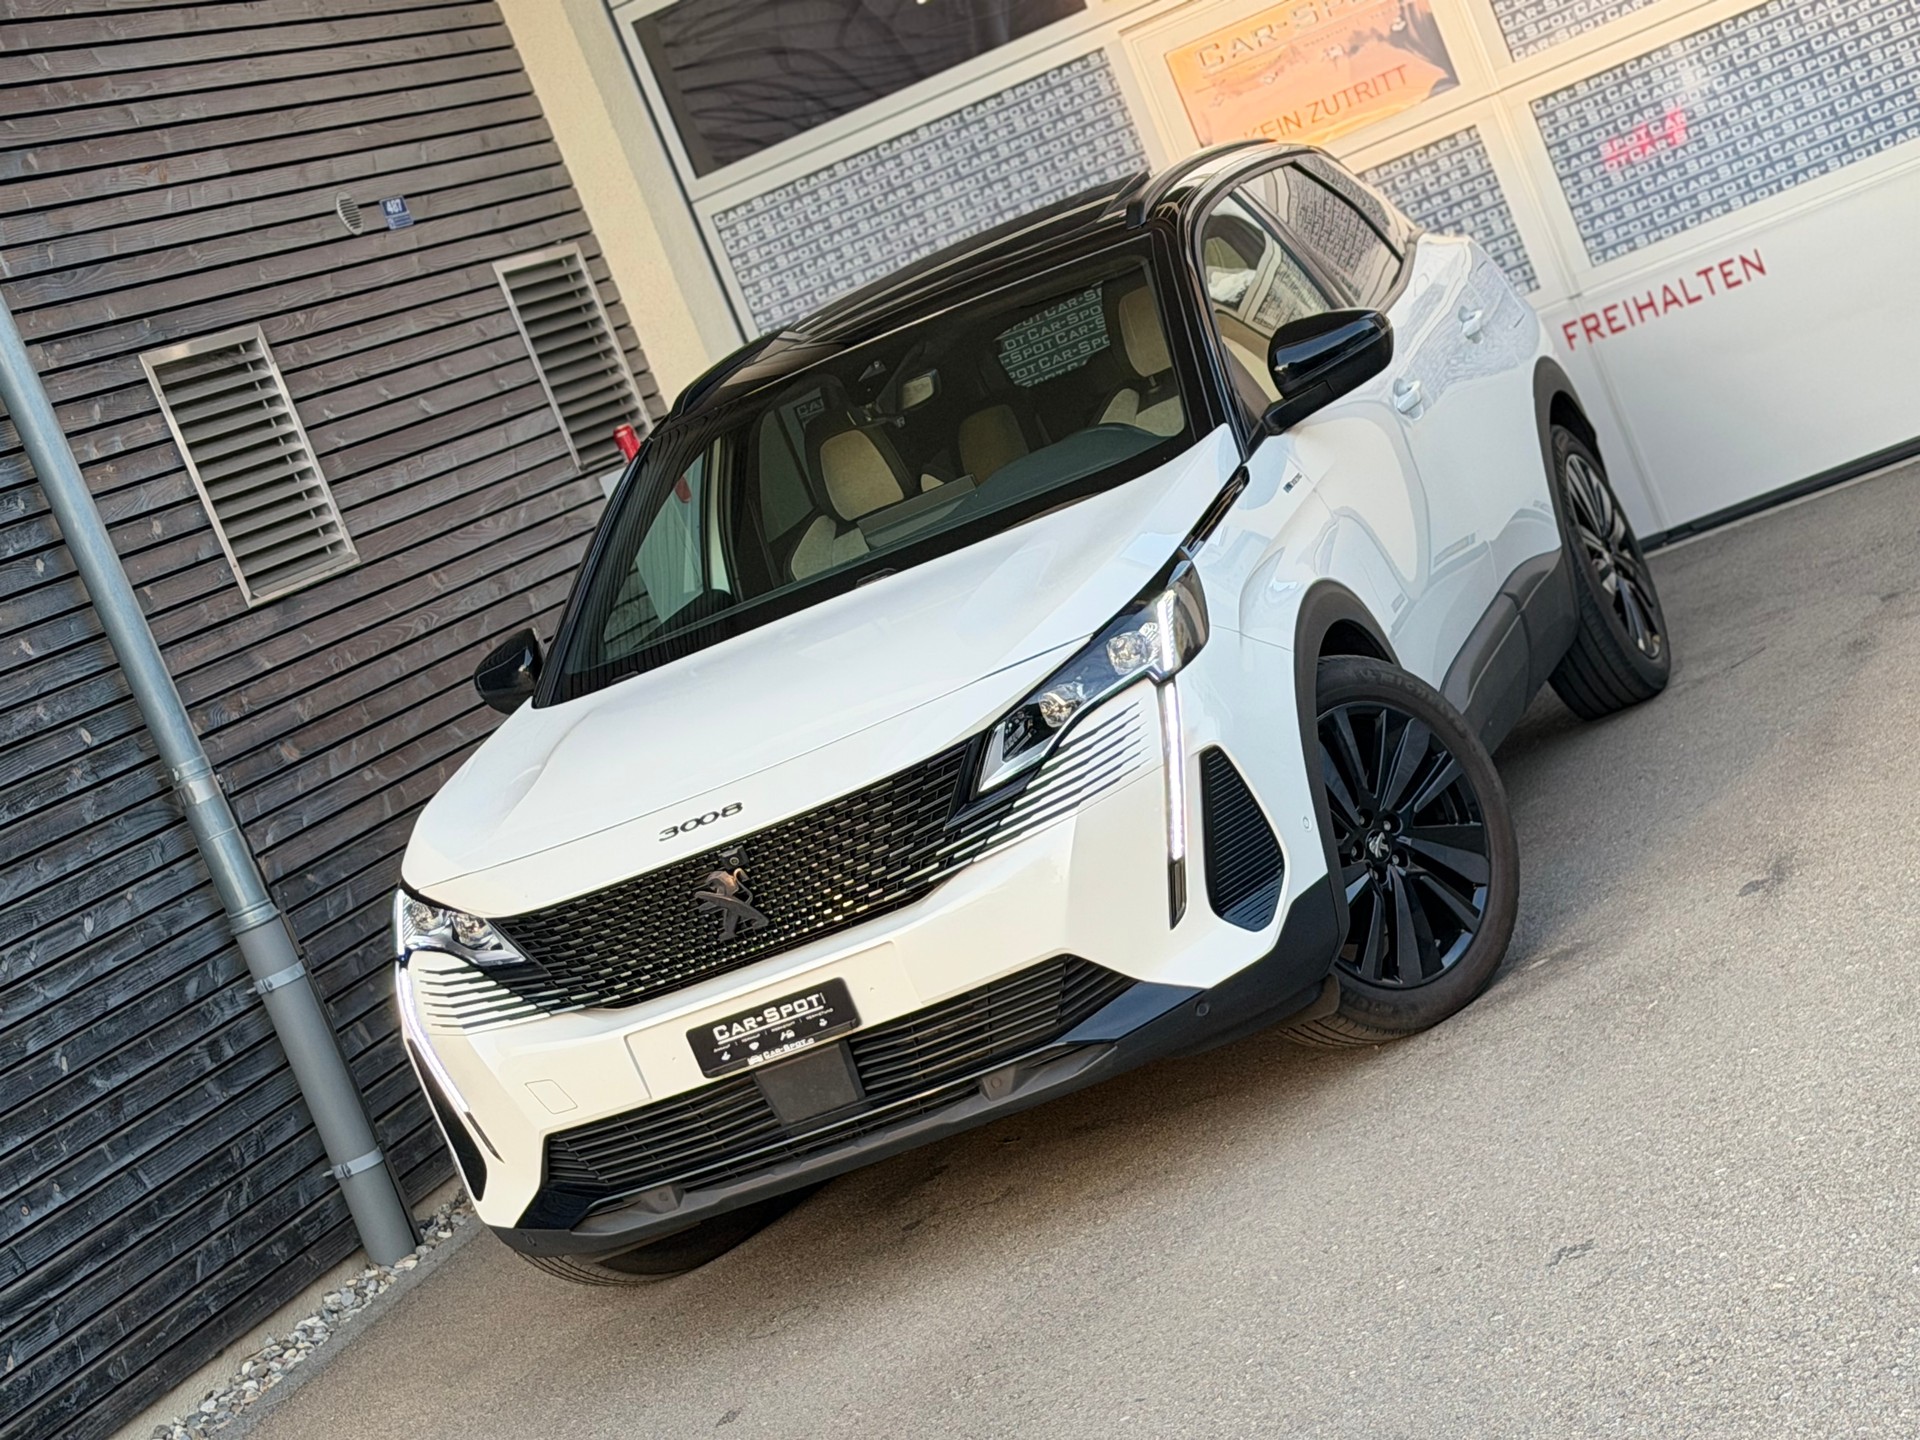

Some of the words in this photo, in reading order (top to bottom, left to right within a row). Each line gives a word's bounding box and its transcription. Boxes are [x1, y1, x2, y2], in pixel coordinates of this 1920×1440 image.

[1512, 14, 1606, 60] CAR-SPOT
[1842, 15, 1920, 55] CAR-SP
[1854, 50, 1920, 85] CAR-S
[1306, 64, 1407, 124] ZUTRITT
[1562, 249, 1767, 351] FREIHALTEN
[658, 802, 743, 842] 3008
[713, 994, 820, 1041] CAR-SPOT
